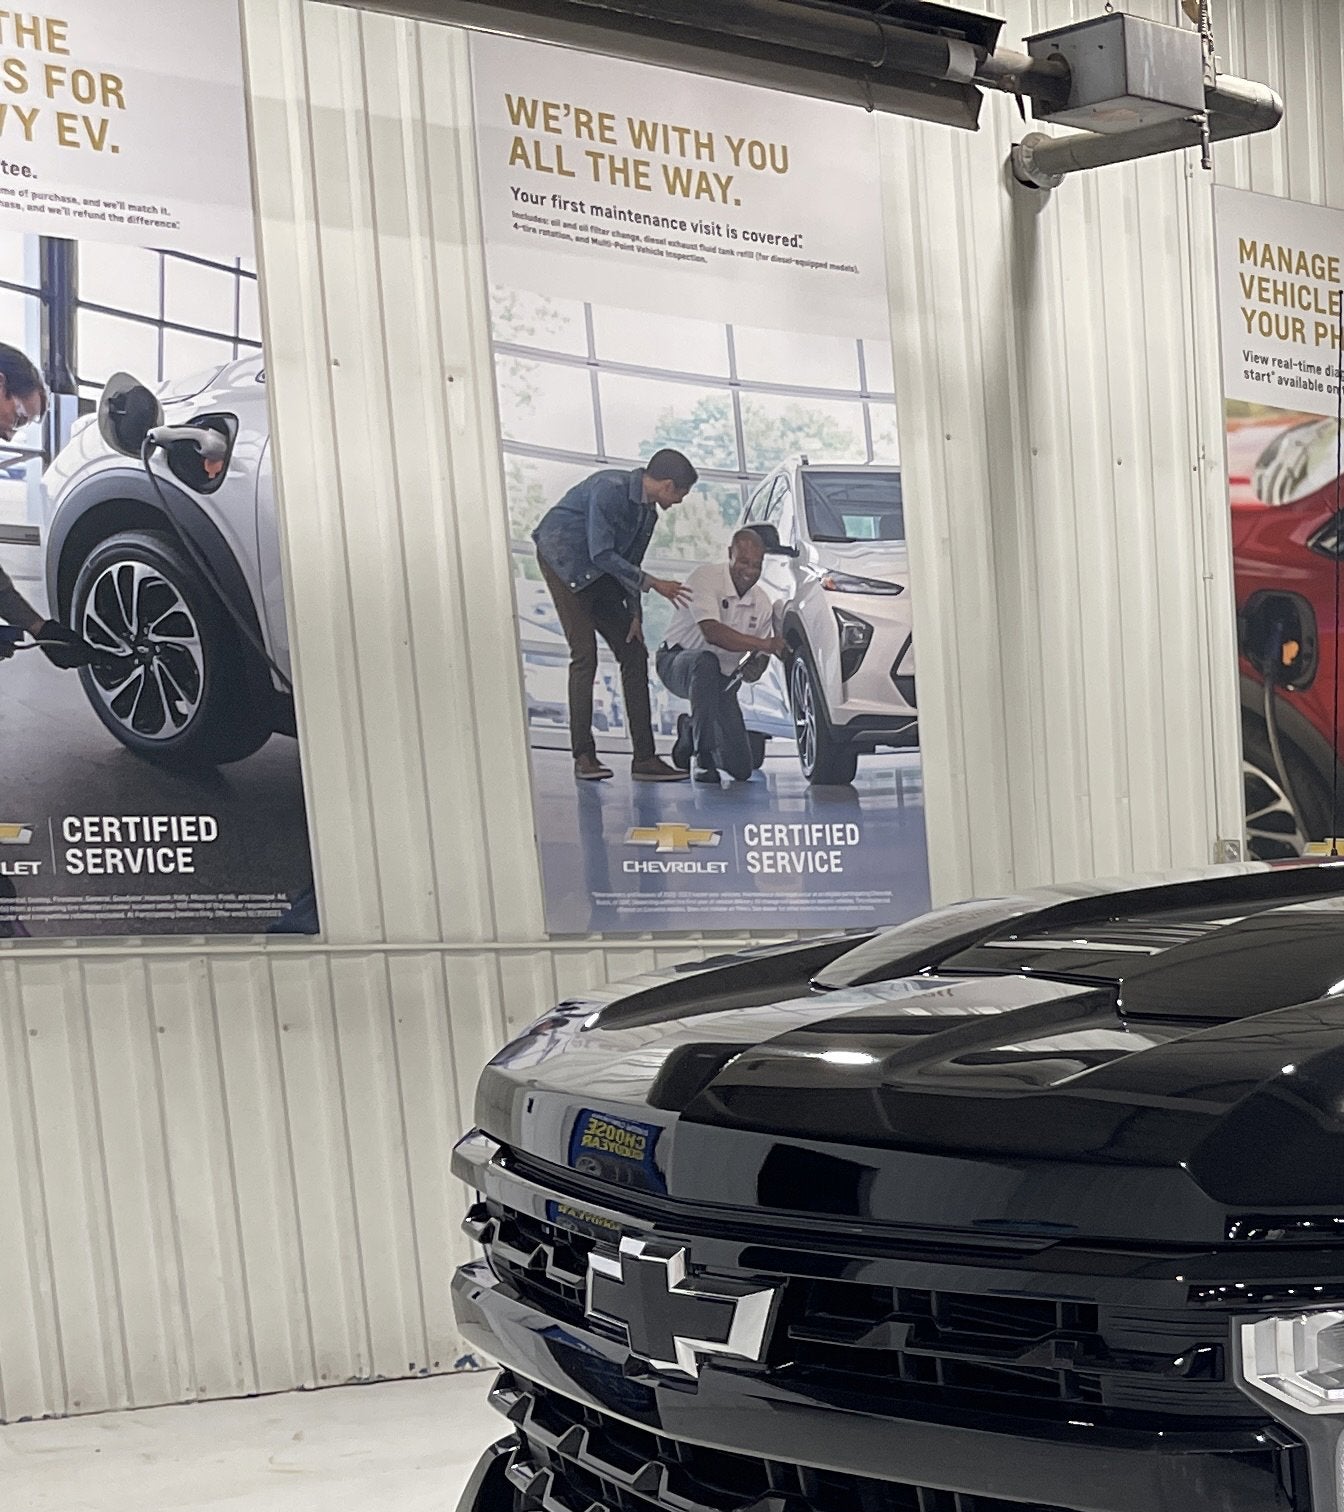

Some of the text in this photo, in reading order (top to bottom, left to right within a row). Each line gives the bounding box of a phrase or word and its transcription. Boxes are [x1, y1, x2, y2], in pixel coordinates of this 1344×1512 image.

[44, 64, 126, 110] FOR
[56, 111, 120, 154] EV.
[504, 93, 789, 175] WE'RE WITH YOU
[508, 136, 741, 206] ALL THE WAY.
[19, 189, 28, 198] of
[83, 199, 100, 208] and
[128, 203, 158, 214] match
[27, 204, 45, 213] and
[73, 209, 105, 221] refund
[108, 212, 124, 223] the
[510, 186, 547, 206] Your
[551, 194, 586, 214] first
[590, 204, 687, 232] maintenance
[691, 219, 722, 238] visit
[726, 223, 738, 240] is
[1238, 237, 1340, 283] MANAGE
[1239, 271, 1341, 317] VEHICLE
[1241, 306, 1306, 345] YOUR
[1242, 349, 1269, 366] View
[1272, 357, 1322, 375] real-time
[1277, 375, 1324, 393] available
[1327, 384, 1339, 394] on
[62, 815, 218, 843] CERTIFIED
[743, 823, 860, 846] CERTIFIED
[65, 847, 195, 874] SERVICE
[622, 860, 729, 874] CHEVROLET
[746, 850, 844, 874] SERVICE
